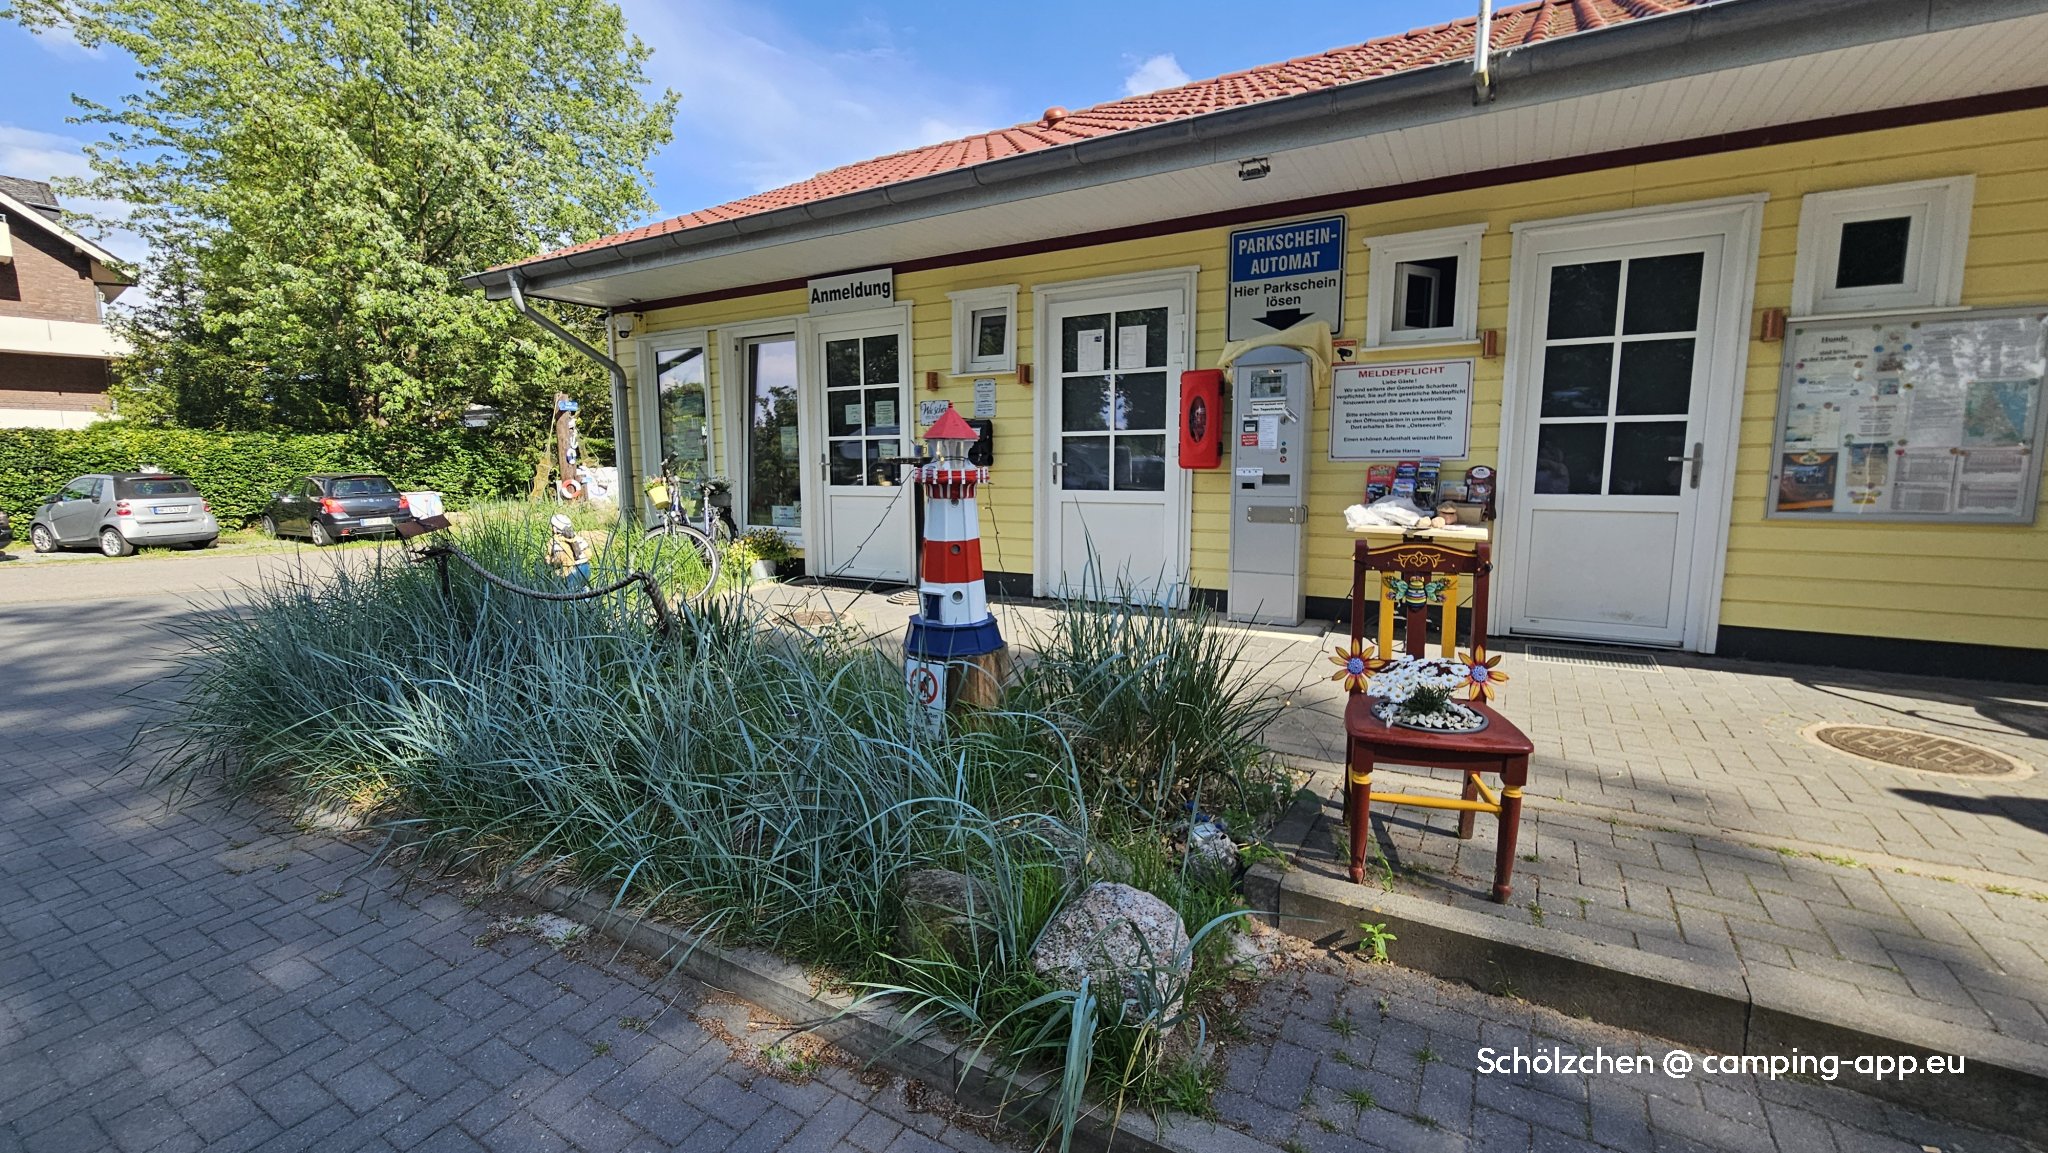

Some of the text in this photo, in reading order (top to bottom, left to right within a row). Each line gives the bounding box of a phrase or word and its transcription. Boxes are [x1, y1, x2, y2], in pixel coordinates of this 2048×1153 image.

[1238, 227, 1337, 255] PARKSCHEIN-
[1250, 251, 1320, 275] AUTOMAT
[811, 281, 890, 304] Anmeldung
[1234, 277, 1336, 297] Hier Parkschein
[1266, 296, 1301, 307] lösen
[1358, 366, 1445, 378] MELDEPFLICHT
